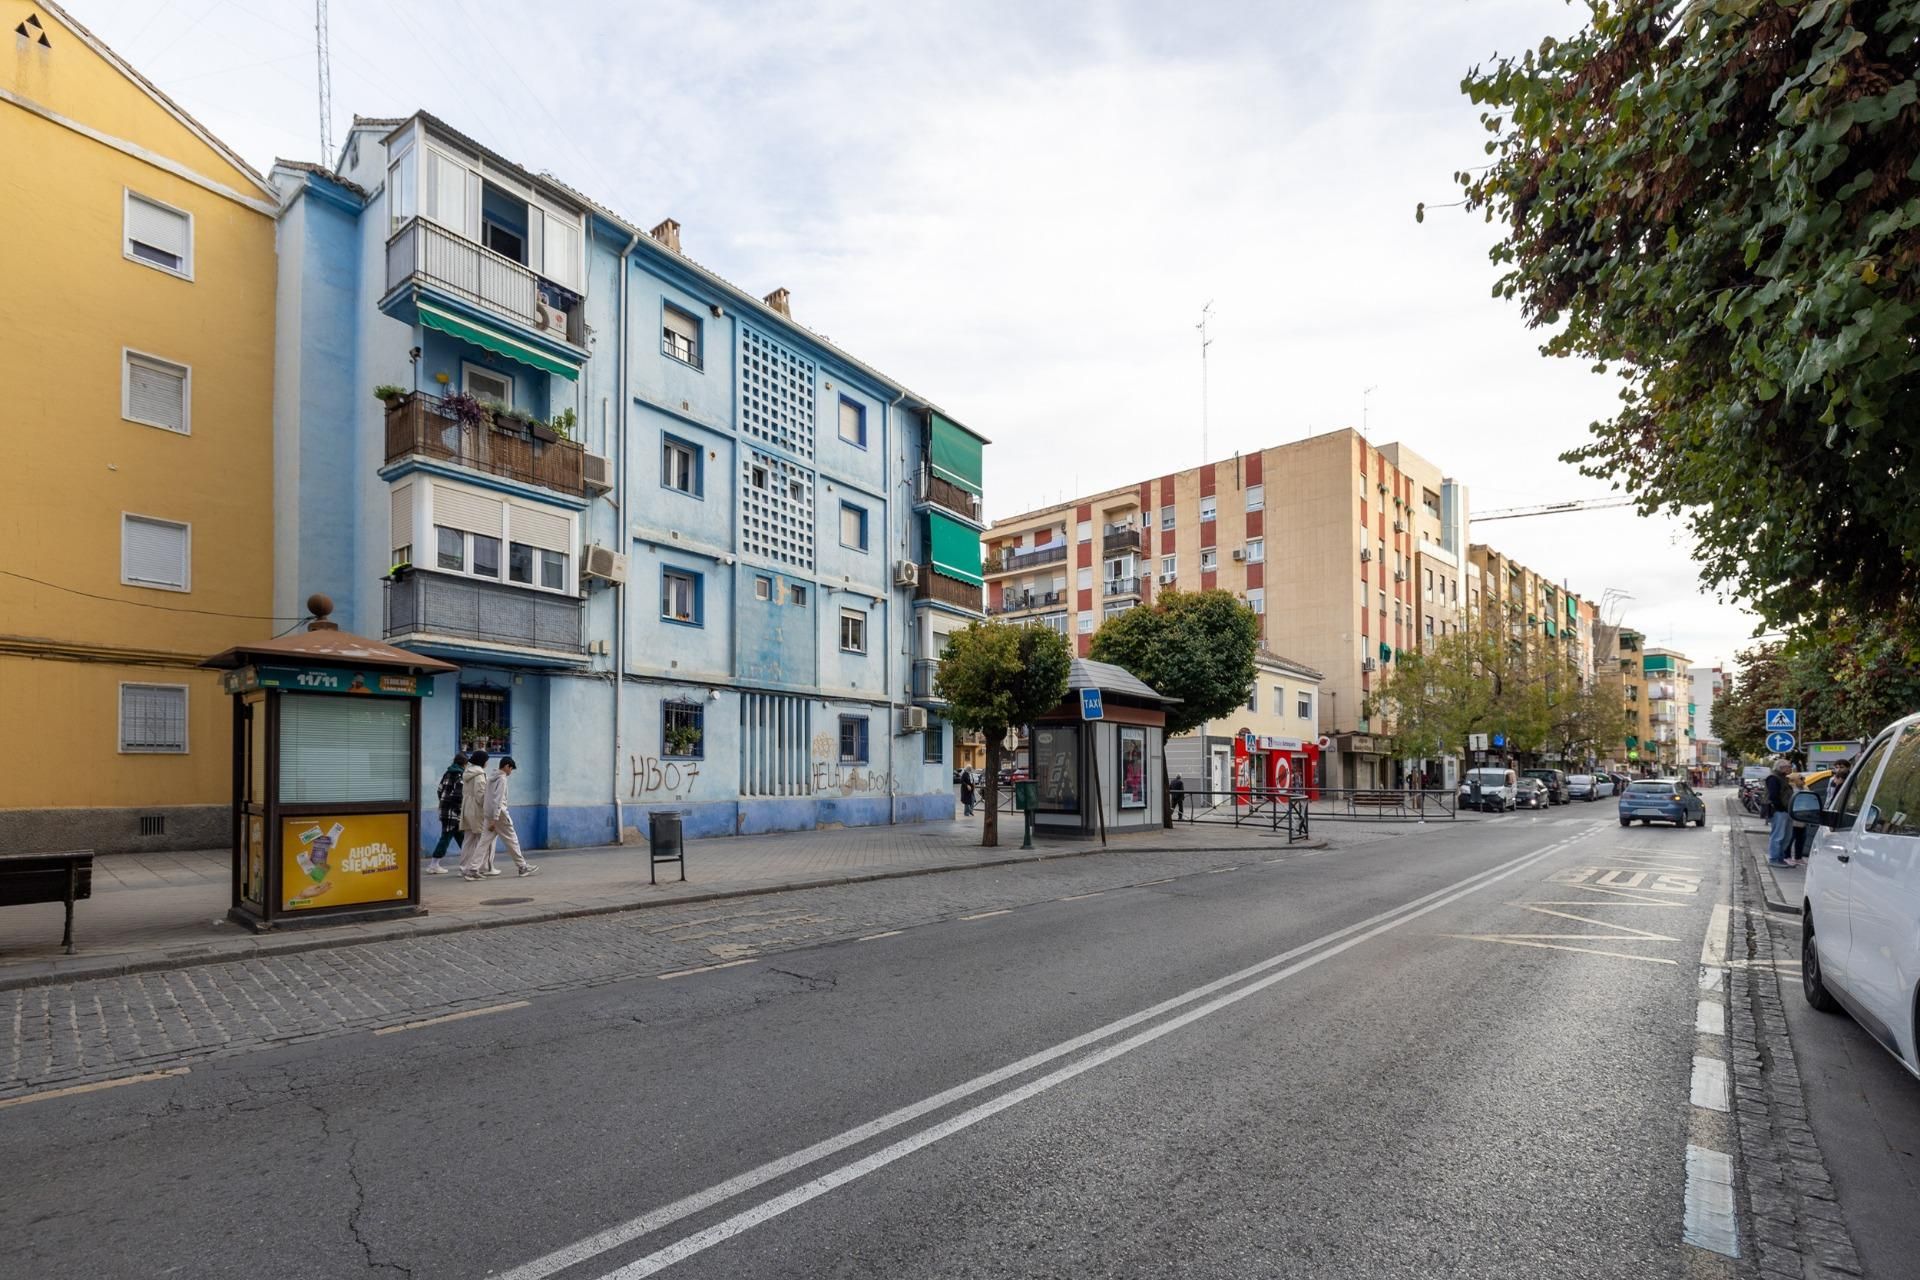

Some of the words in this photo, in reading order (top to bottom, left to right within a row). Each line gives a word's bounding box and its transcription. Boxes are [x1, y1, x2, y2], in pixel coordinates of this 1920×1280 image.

[297, 674, 338, 688] 11/11
[1085, 699, 1102, 710] TAXI
[349, 842, 388, 860] AHORA
[342, 852, 397, 873] SIEMPRE
[1543, 867, 1704, 894] BUS
